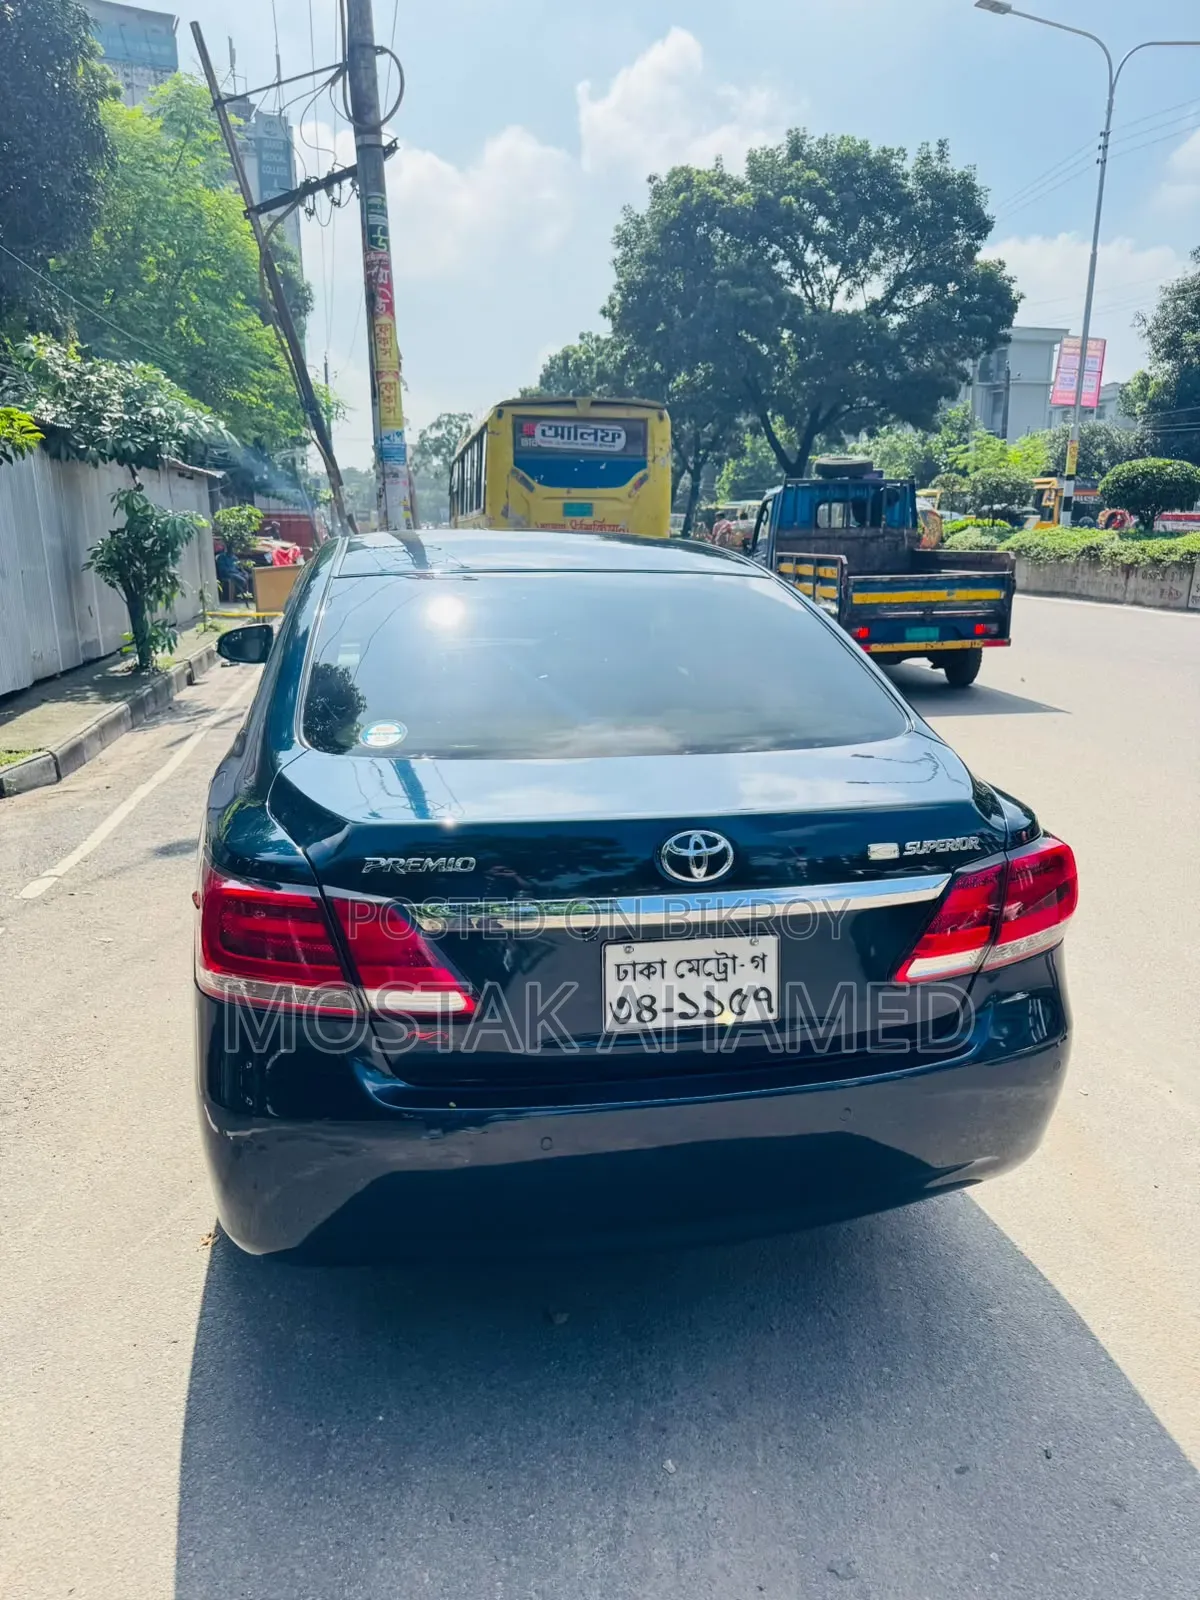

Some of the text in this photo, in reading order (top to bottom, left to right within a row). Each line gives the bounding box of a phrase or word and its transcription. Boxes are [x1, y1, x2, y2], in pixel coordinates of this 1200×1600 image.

[540, 424, 623, 443] আলিফ
[902, 836, 981, 856] SUPERIOR
[361, 857, 477, 875] PREMIO
[615, 958, 667, 981] ঢাকা
[609, 986, 774, 1024] ৩৪-১১৫৭
